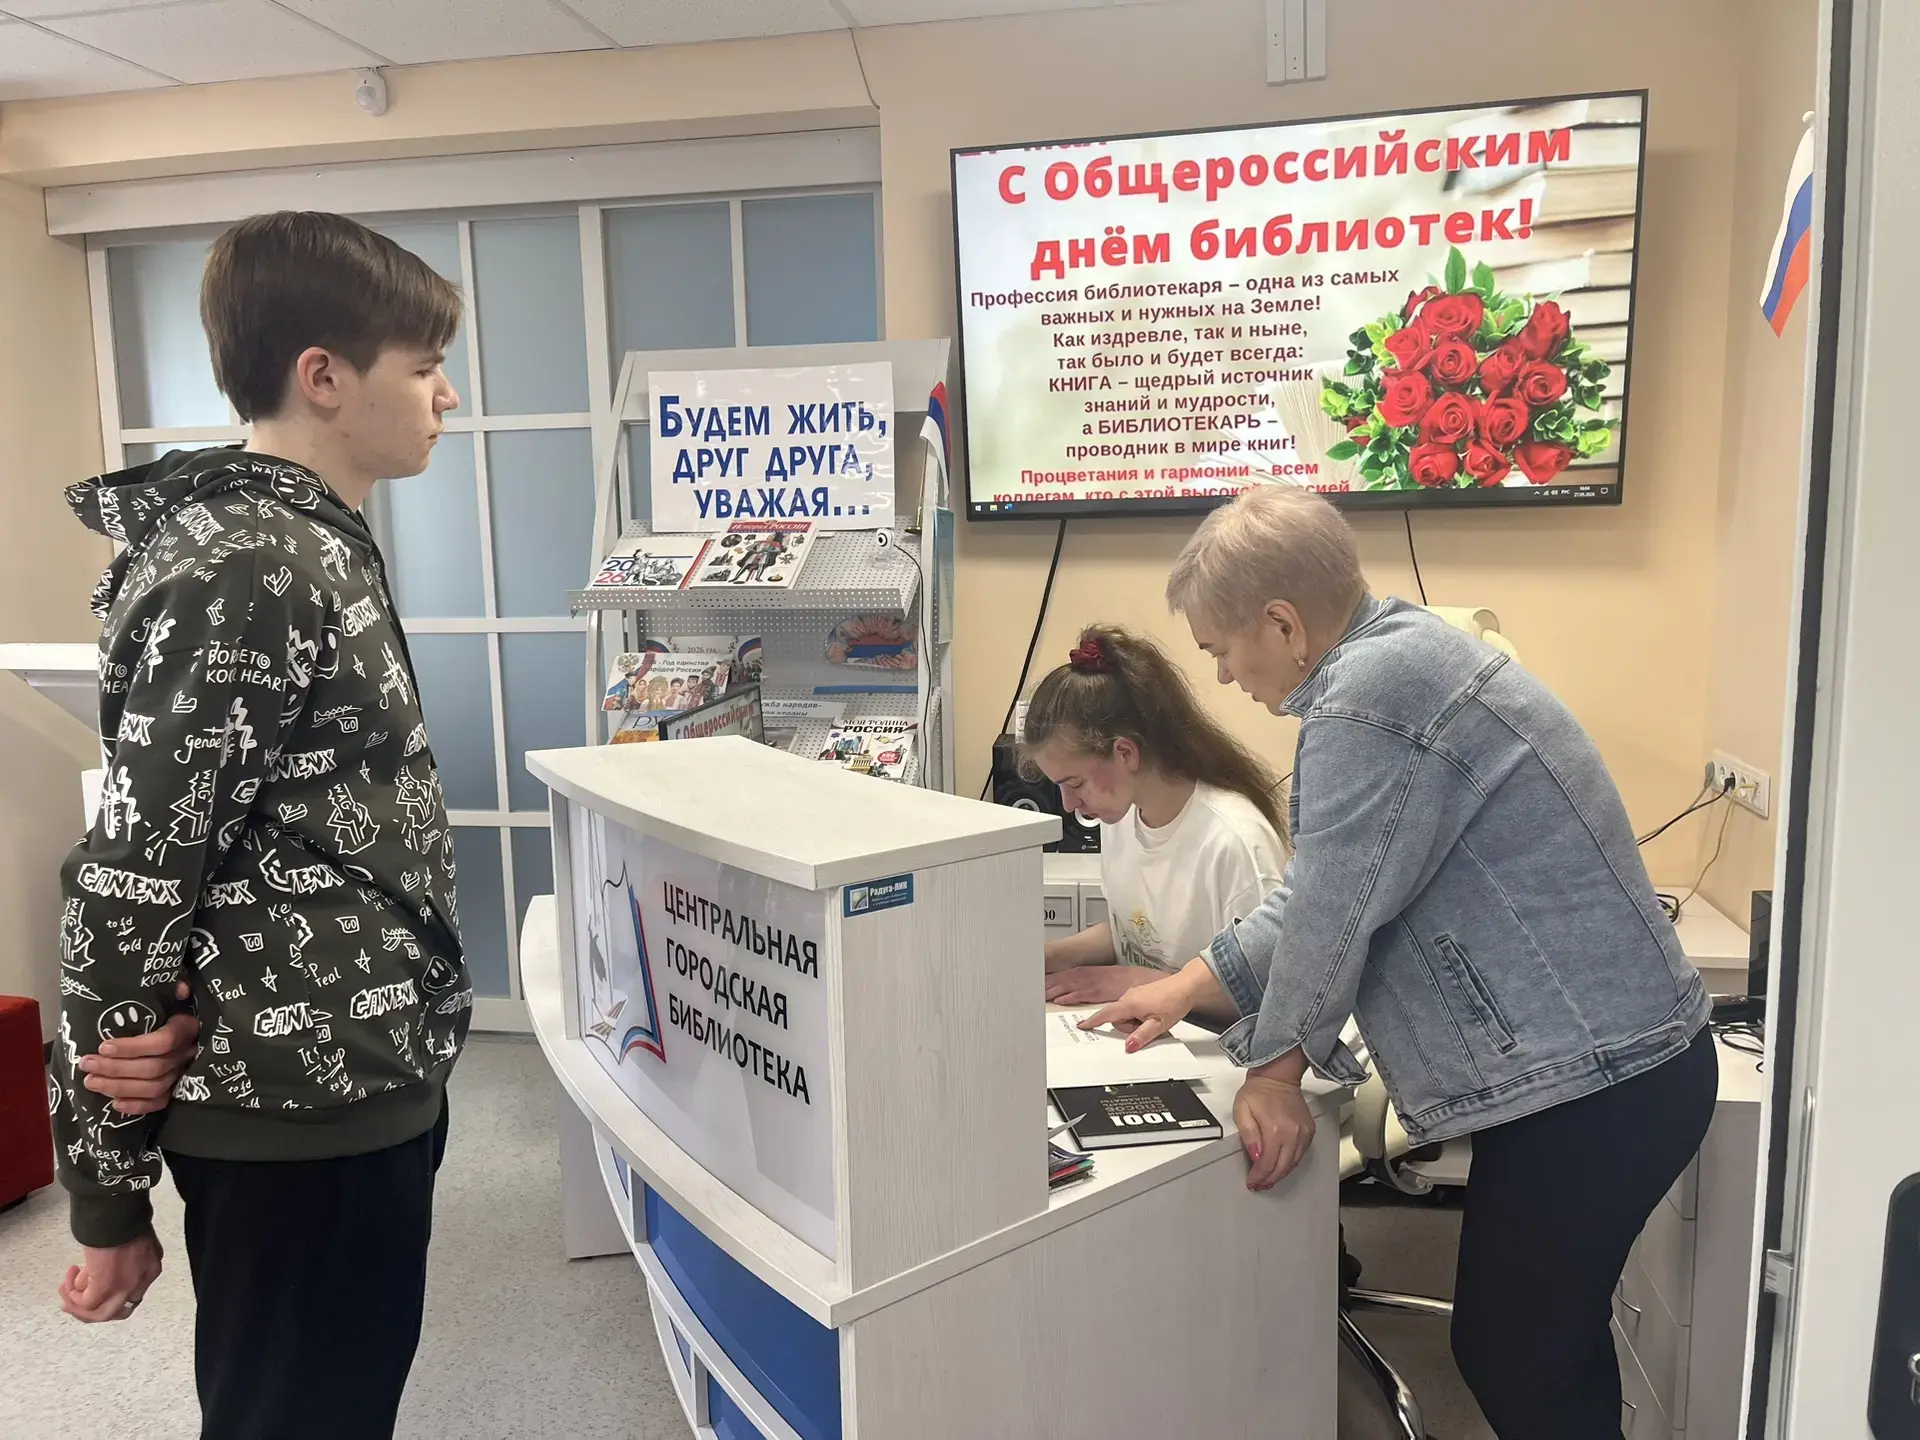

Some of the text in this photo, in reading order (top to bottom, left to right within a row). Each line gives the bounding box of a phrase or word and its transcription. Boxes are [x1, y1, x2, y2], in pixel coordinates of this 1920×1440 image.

[998, 128, 1571, 204] С Общероссийским
[1030, 198, 1533, 281] днём библиотек!
[971, 288, 1078, 310] Профессия
[1084, 280, 1222, 300] библиотекаря
[1246, 275, 1295, 295] одна
[1302, 274, 1324, 288] из
[1330, 269, 1399, 286] самых
[1041, 295, 1321, 326] важных и нужных на Земле!
[1053, 322, 1308, 349] Как издревле, так и ныне,
[1057, 345, 1303, 370] так было и будет всегда:
[1049, 375, 1112, 392] КНИГА
[1135, 368, 1214, 390] щедрый
[1221, 367, 1313, 385] источник
[1084, 393, 1275, 413] знаний и мудрости,
[787, 401, 887, 438] ЖИТЬ,
[1082, 423, 1093, 436] а
[1098, 414, 1261, 434] БИБЛИОТЕКАРЬ
[1066, 435, 1297, 461] проводник в мире книг!
[672, 444, 873, 484] ДРУГ ДРУГА,
[1021, 468, 1138, 487] Процветания
[1144, 468, 1155, 480] и
[1161, 465, 1249, 482] гармонии
[1271, 463, 1318, 476] всем
[693, 487, 870, 519] УВАЖАЯ...
[602, 560, 636, 571] 20
[843, 725, 904, 734] РОССИЯ
[663, 881, 818, 979] ЦЕНТРАЛЬНАЯ
[666, 937, 788, 1030] ГОРОДСКАЯ
[668, 992, 811, 1106] БИБЛИОТЕКА
[1105, 1103, 1166, 1112] СПОСОБ
[1109, 1112, 1177, 1127] 1001
